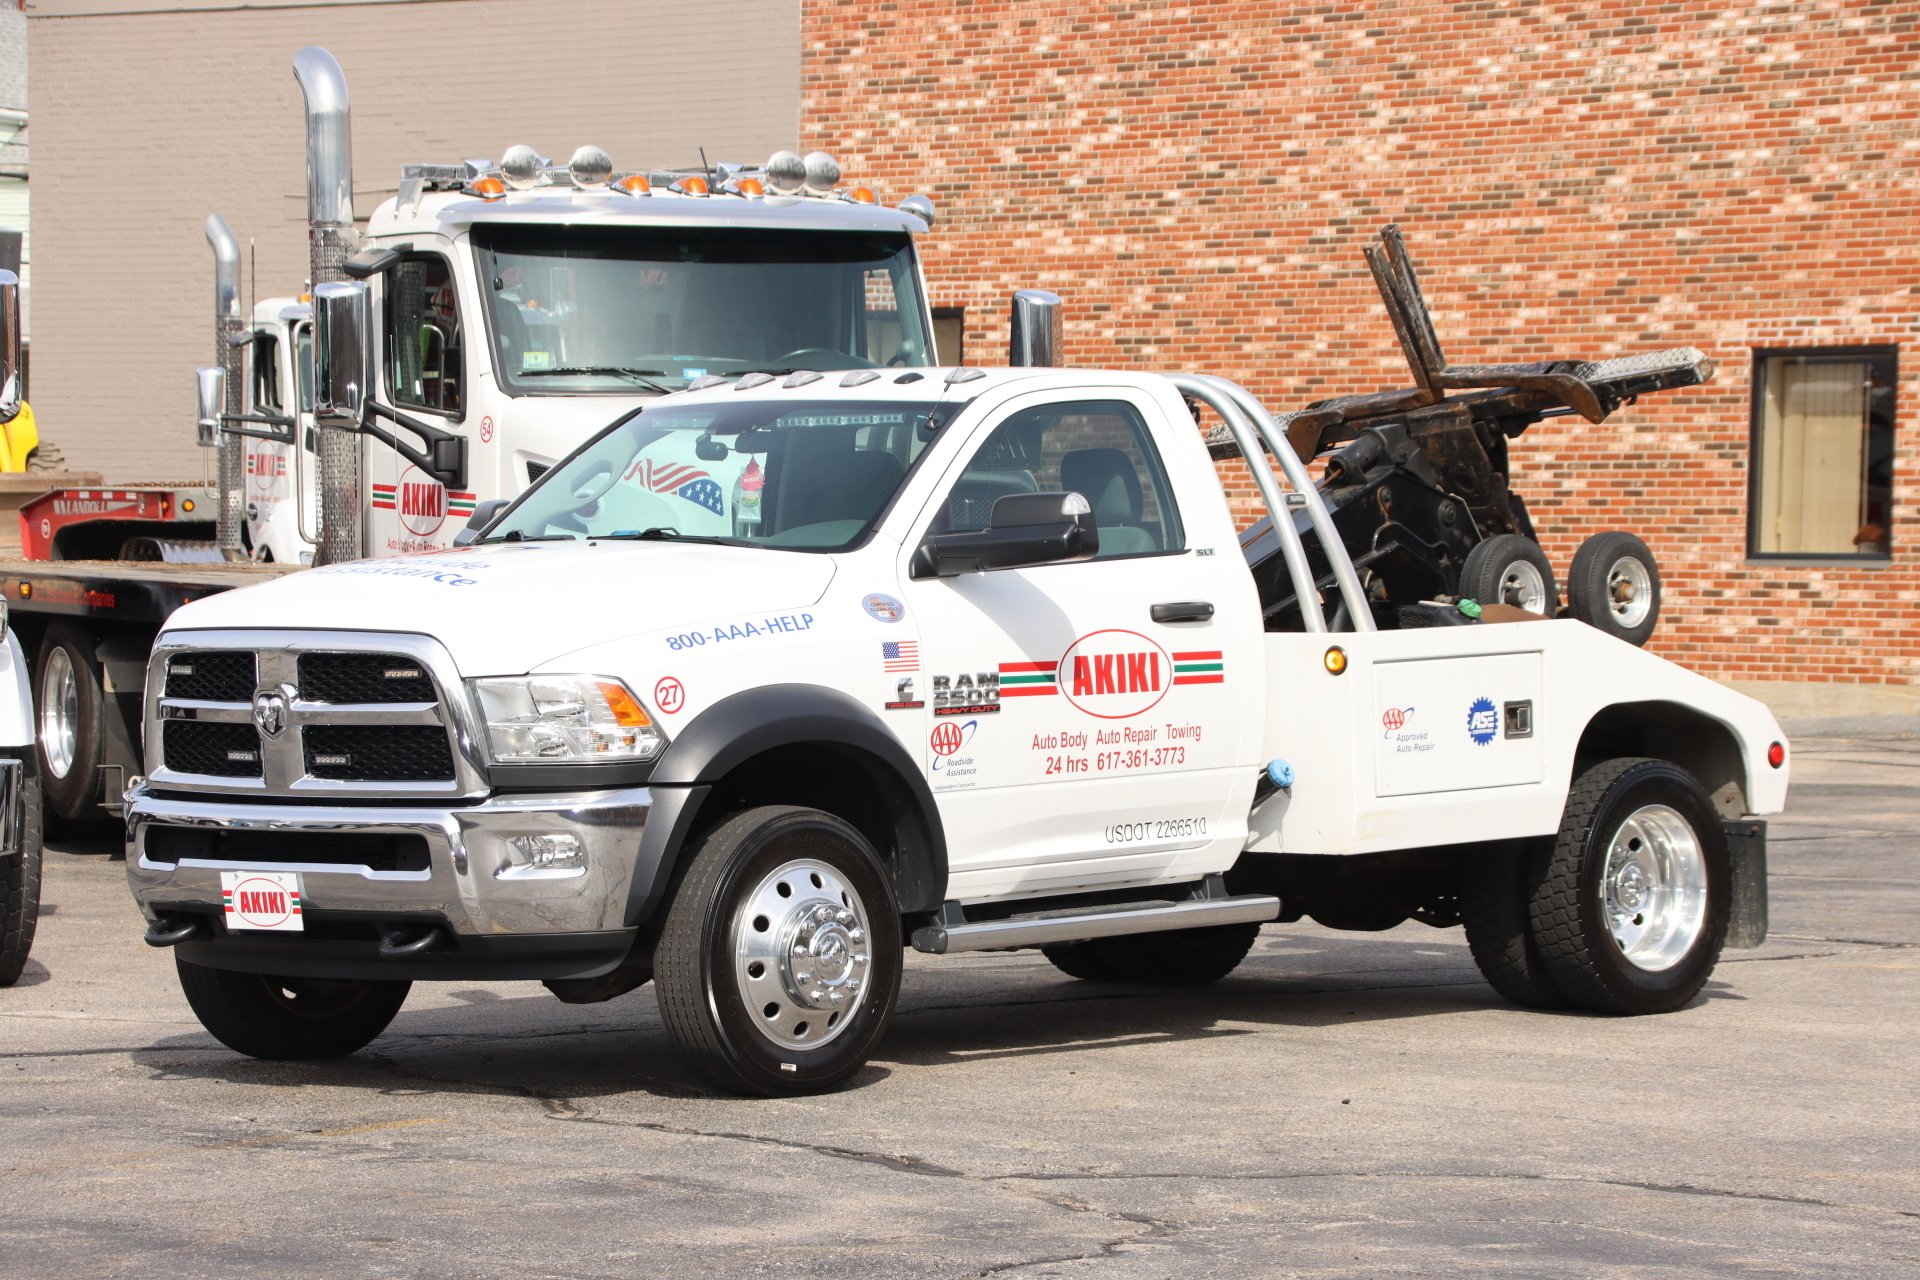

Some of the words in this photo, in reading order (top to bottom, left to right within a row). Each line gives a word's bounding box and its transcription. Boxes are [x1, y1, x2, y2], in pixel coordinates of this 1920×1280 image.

[482, 422, 491, 433] 54
[402, 482, 442, 517] AKIKI
[1195, 548, 1215, 557] SLT
[666, 613, 814, 651] 800-AAA-HELP
[933, 672, 1000, 690] RAM
[1073, 652, 1160, 696] AKIKI
[660, 684, 678, 706] 27
[933, 688, 1000, 707] 5500
[1470, 710, 1495, 729] ASE
[1032, 734, 1057, 750] Auto
[1060, 731, 1088, 750] Body
[1096, 729, 1121, 745] Auto
[1124, 725, 1158, 746] Repair
[1166, 723, 1202, 742] Towing
[1396, 732, 1428, 742] Approved
[1396, 743, 1412, 753] Auto
[1414, 743, 1435, 752] Repair
[946, 757, 974, 767] Roadside
[1046, 756, 1062, 774] 24
[1066, 755, 1088, 773] hrs
[1097, 746, 1185, 771] 617-361-3773
[946, 769, 977, 777] Assistance
[1105, 821, 1152, 843] USDOT
[1156, 817, 1207, 839] 2266510
[240, 891, 286, 914] AKIKI
